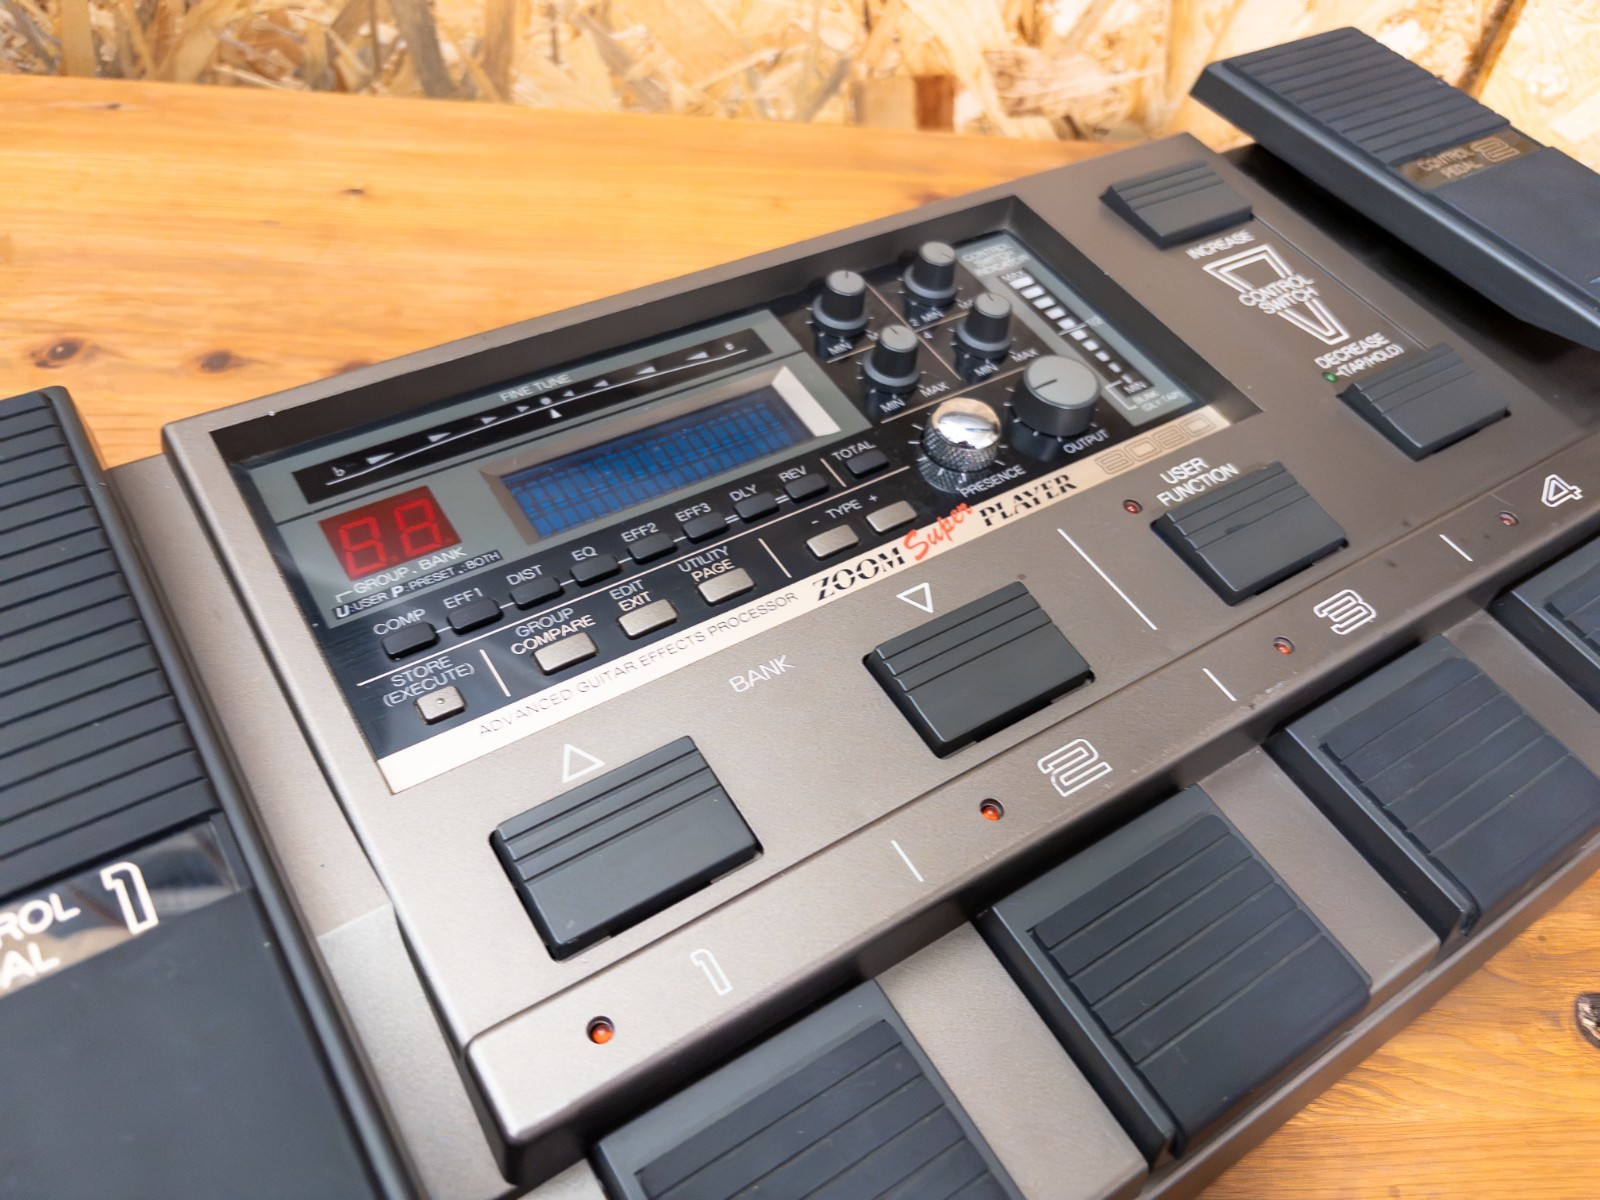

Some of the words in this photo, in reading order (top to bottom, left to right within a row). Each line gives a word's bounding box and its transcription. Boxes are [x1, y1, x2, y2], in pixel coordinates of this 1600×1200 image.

[1470, 136, 1520, 163] 2
[1185, 230, 1255, 259] INCREASE
[1238, 274, 1316, 307] CONTROL
[1258, 286, 1319, 315] SWITCH
[1011, 348, 1039, 362] MAX
[1314, 332, 1391, 369] DECREASE
[974, 362, 998, 376] MIN
[500, 385, 533, 402] FINE
[534, 373, 573, 394] TUNE
[920, 382, 950, 398] MAX
[880, 397, 906, 412] MIN
[831, 440, 876, 461] TOTAL
[1063, 429, 1110, 454] OUTPUT
[778, 465, 807, 483] REV
[959, 464, 1026, 498] PRESENCE
[1160, 457, 1209, 484] USER
[729, 484, 757, 501] DLY
[1156, 463, 1239, 507] FUNCTION
[1541, 474, 1583, 507] 4
[675, 502, 711, 522] EFF3
[825, 499, 862, 519] TYPE
[621, 522, 658, 543] EFF2
[571, 546, 598, 562] EQ
[677, 546, 729, 573] UTILITY
[354, 567, 409, 594] GROUP
[418, 547, 468, 571] BANK
[479, 688, 571, 736] ADVANCED
[577, 660, 637, 694] GUITAR
[641, 632, 705, 666] EFFECTS
[707, 592, 799, 640] PROCESSOR
[813, 547, 905, 601] ZOOM
[904, 503, 973, 561] Super
[979, 474, 1077, 526] PLAYER
[1095, 415, 1216, 475] 8080
[506, 565, 543, 586] DIST
[691, 559, 735, 582] PAGE
[443, 588, 484, 609] EFF1
[610, 580, 645, 601] EDIT
[618, 591, 651, 612] EXIT
[373, 608, 426, 635] COMP
[515, 607, 575, 637] GROUP
[1313, 589, 1377, 635] 3
[510, 615, 596, 655] COMPARE
[383, 663, 475, 707] (EXECUTE)
[391, 656, 453, 687] STORE
[728, 655, 796, 693] BANK
[1037, 738, 1113, 797] 2
[100, 861, 159, 935] 1
[690, 948, 733, 996] 1
